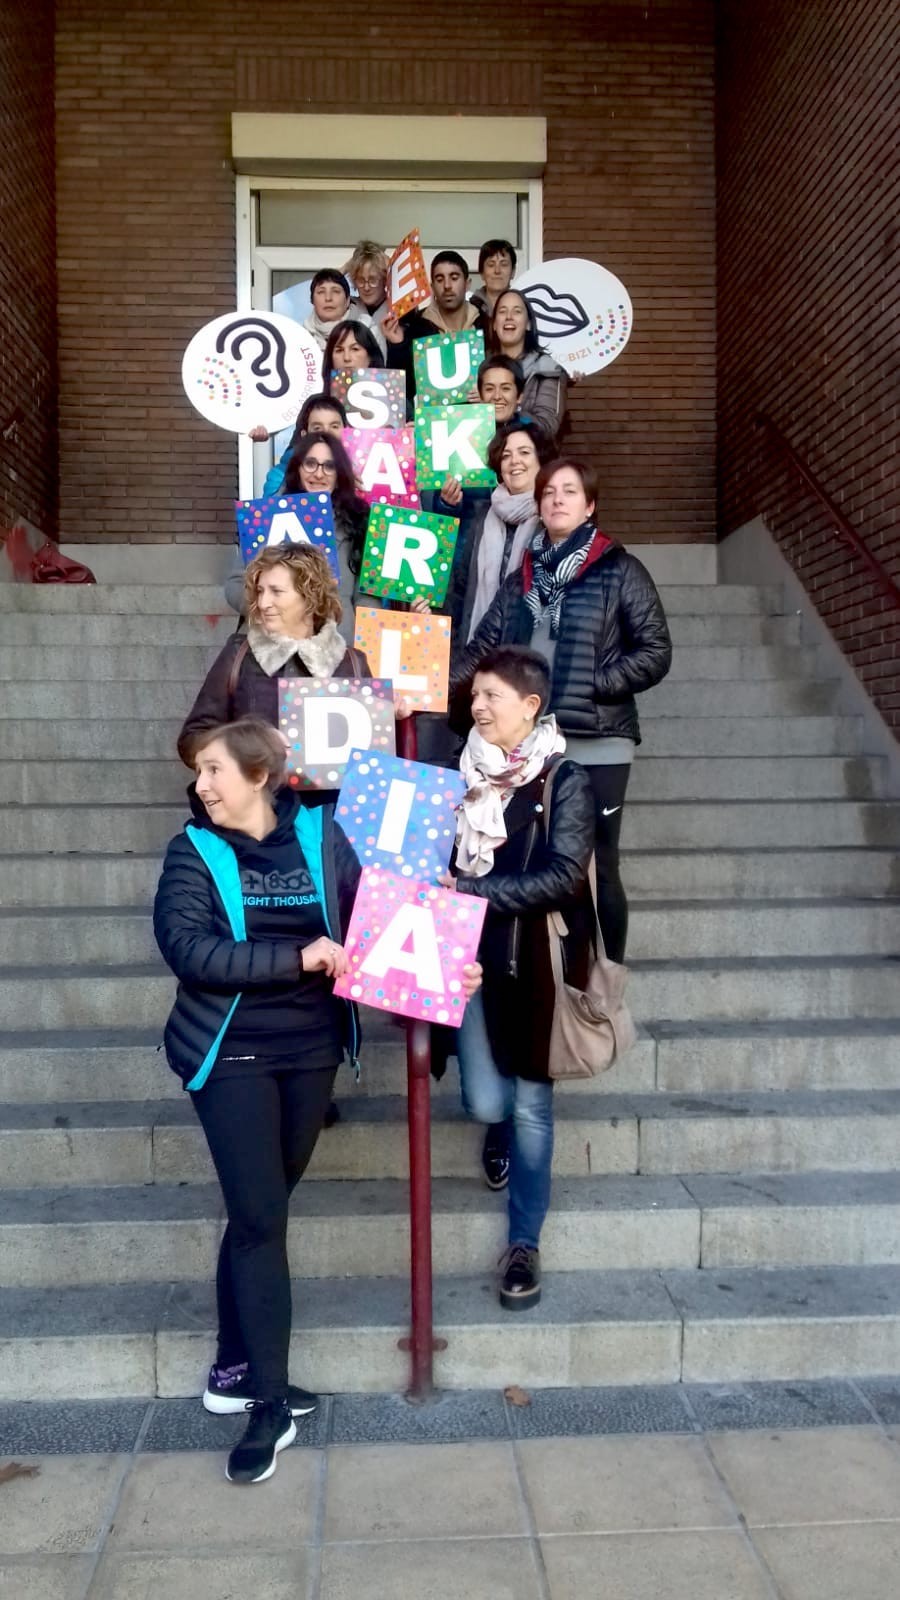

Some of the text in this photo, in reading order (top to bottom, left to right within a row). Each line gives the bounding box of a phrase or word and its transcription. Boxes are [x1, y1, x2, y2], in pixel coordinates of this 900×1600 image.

[391, 247, 417, 304] E
[426, 342, 471, 390] U
[346, 380, 390, 429] S
[361, 441, 407, 495] A
[431, 418, 487, 471] K
[380, 522, 438, 587] R
[378, 628, 429, 691] L
[303, 696, 373, 765] D
[376, 778, 417, 855] I
[242, 896, 271, 907] IGHT
[358, 902, 445, 994] A
